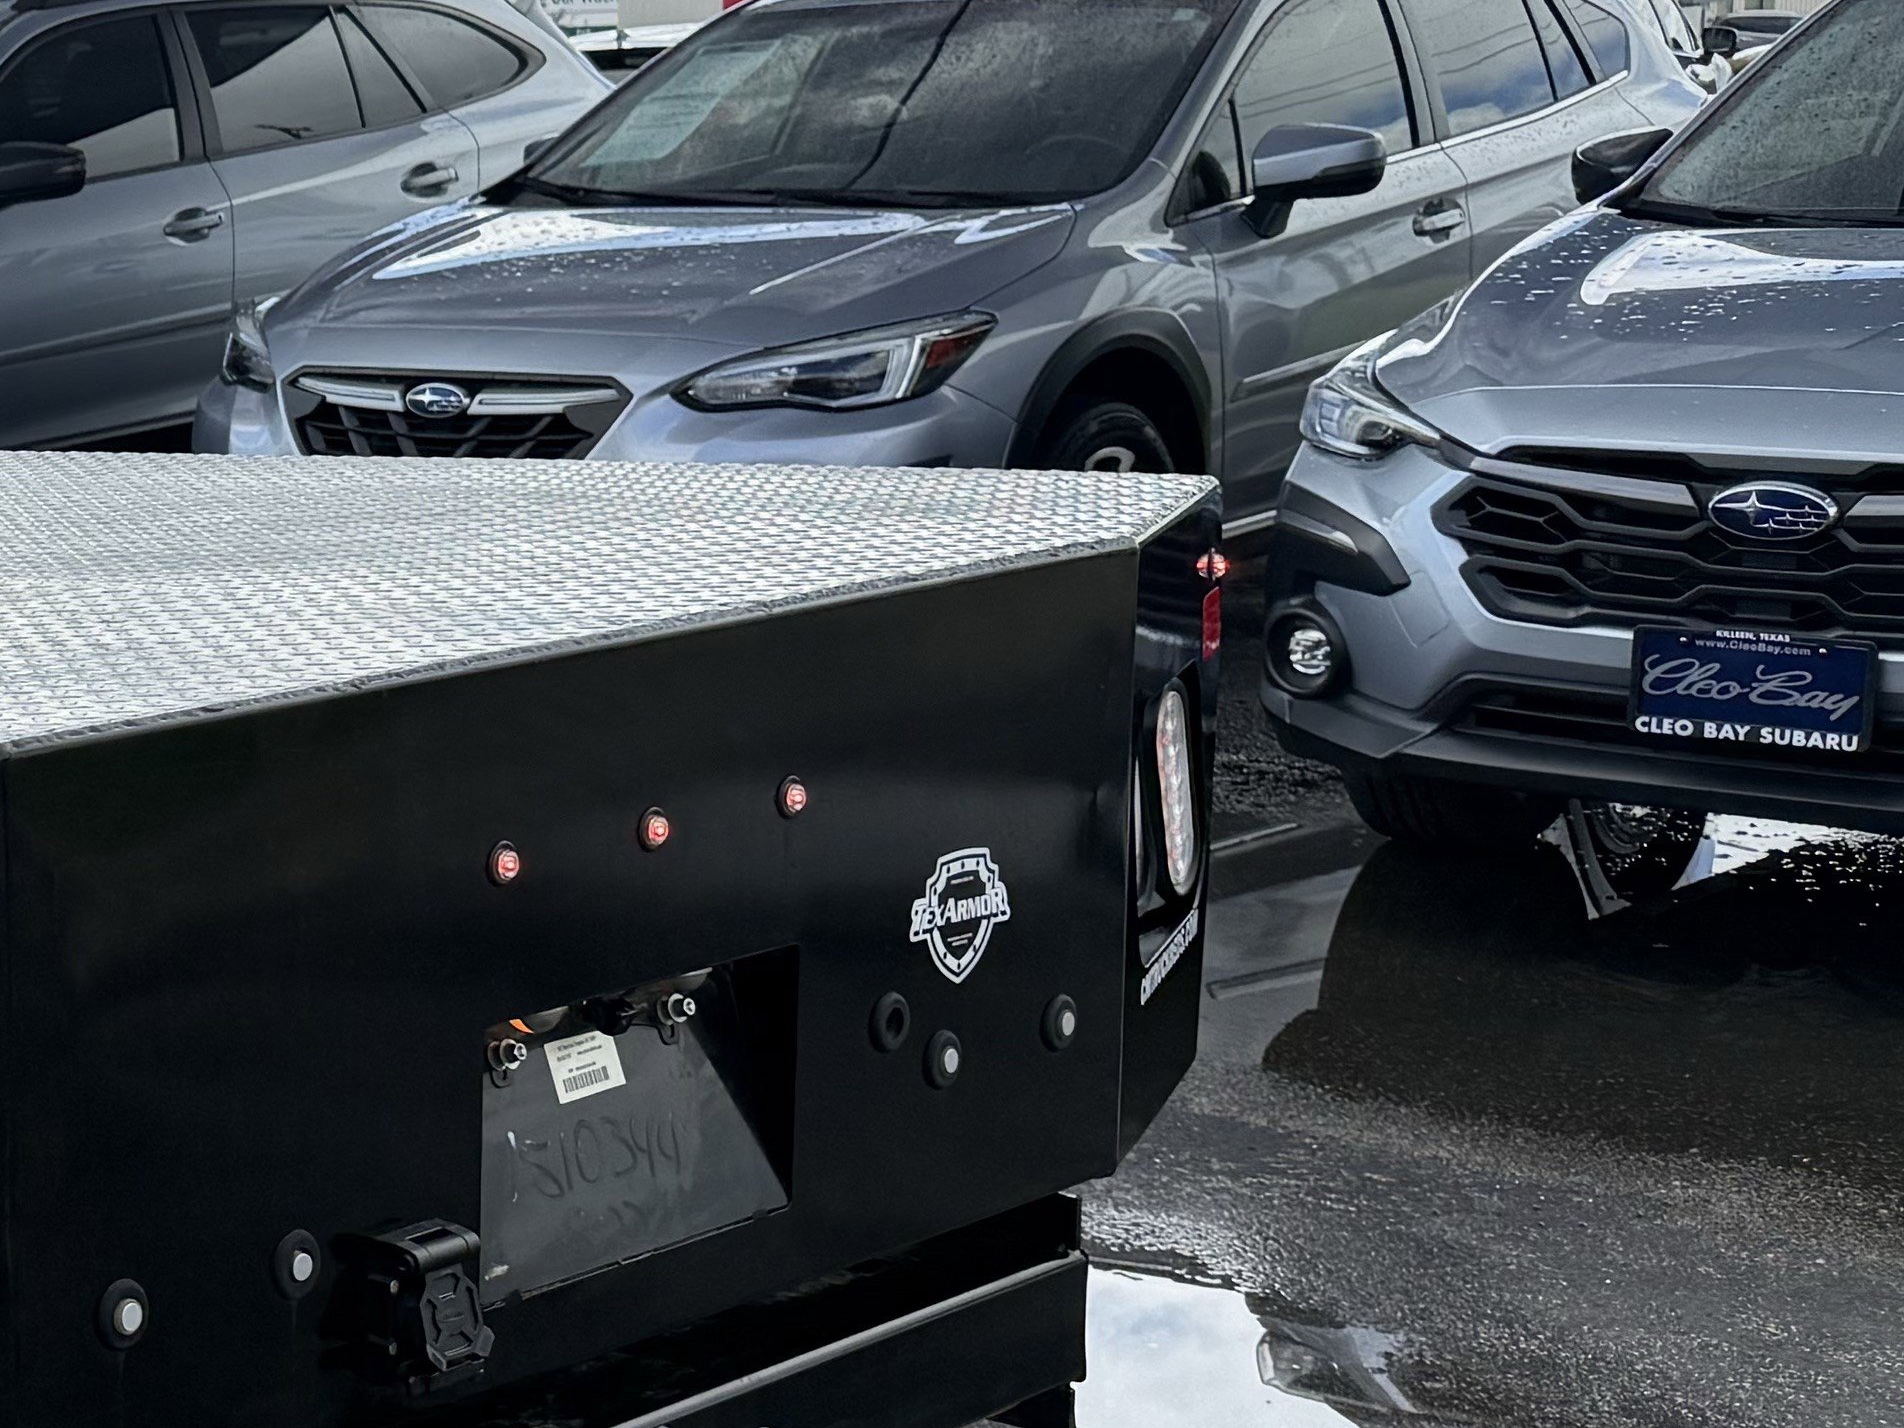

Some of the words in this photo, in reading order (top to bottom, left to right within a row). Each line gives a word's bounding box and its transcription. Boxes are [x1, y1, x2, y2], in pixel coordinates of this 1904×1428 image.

[1695, 638, 1811, 656] www.CleoBay.com
[1759, 632, 1790, 643] TEXAS
[1642, 654, 1748, 700] Cleo
[1749, 664, 1860, 721] Bay
[1634, 716, 1694, 736] CLEO
[1703, 722, 1751, 741] BAY
[1759, 727, 1859, 752] SUBARU
